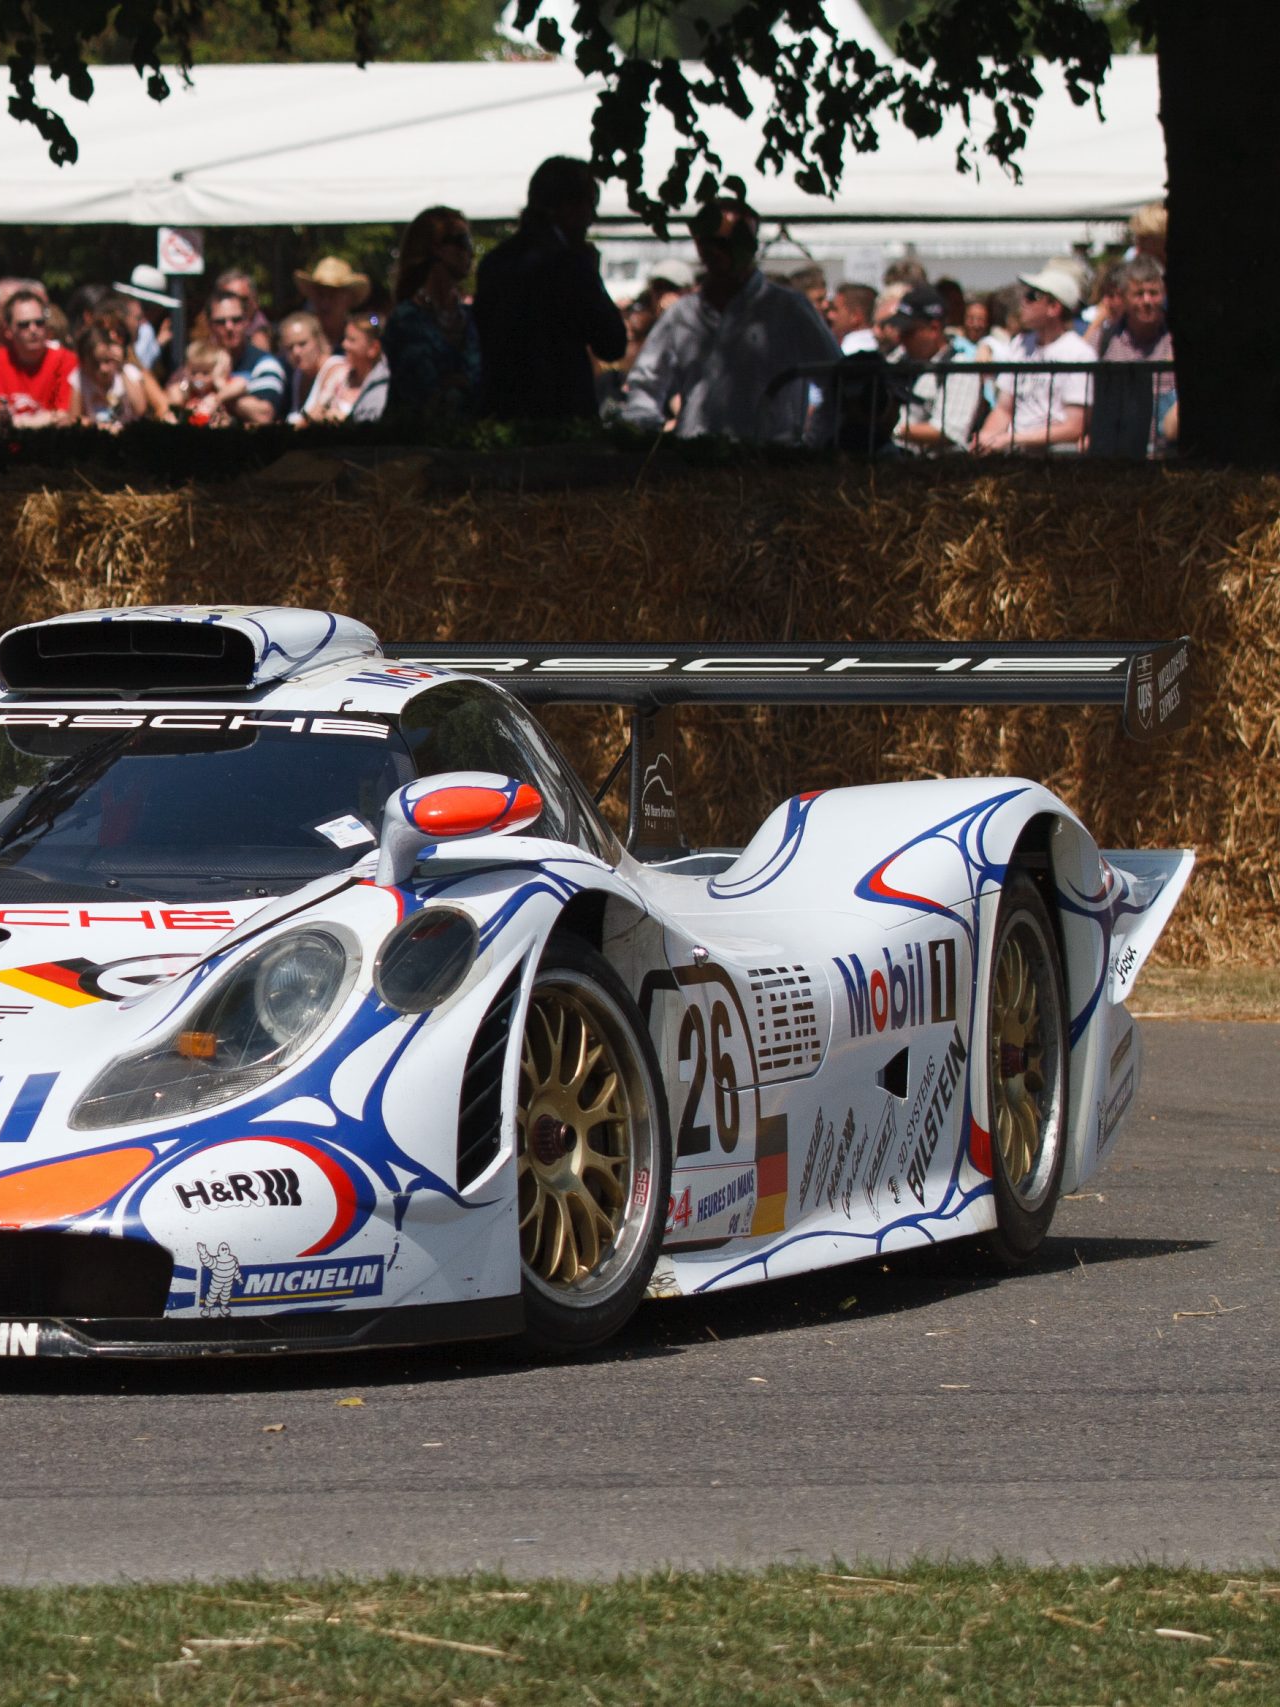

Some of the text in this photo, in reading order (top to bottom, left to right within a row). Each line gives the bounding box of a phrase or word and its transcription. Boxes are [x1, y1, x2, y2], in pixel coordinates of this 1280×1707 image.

[345, 664, 451, 689] Mob
[399, 657, 1127, 671] RSCHE
[1138, 682, 1152, 717] ups
[832, 942, 925, 1038] Mobil
[747, 964, 821, 1072] IBM
[677, 1000, 741, 1154] 26
[907, 1055, 936, 1145] SYSTEMS
[907, 1024, 968, 1208] BILSTEIN
[176, 1171, 261, 1211] H&R
[634, 1168, 649, 1206] BBS
[697, 1187, 726, 1223] HEURES
[727, 1182, 737, 1207] DU
[737, 1168, 754, 1197] MANS
[243, 1264, 380, 1295] MICHELIN
